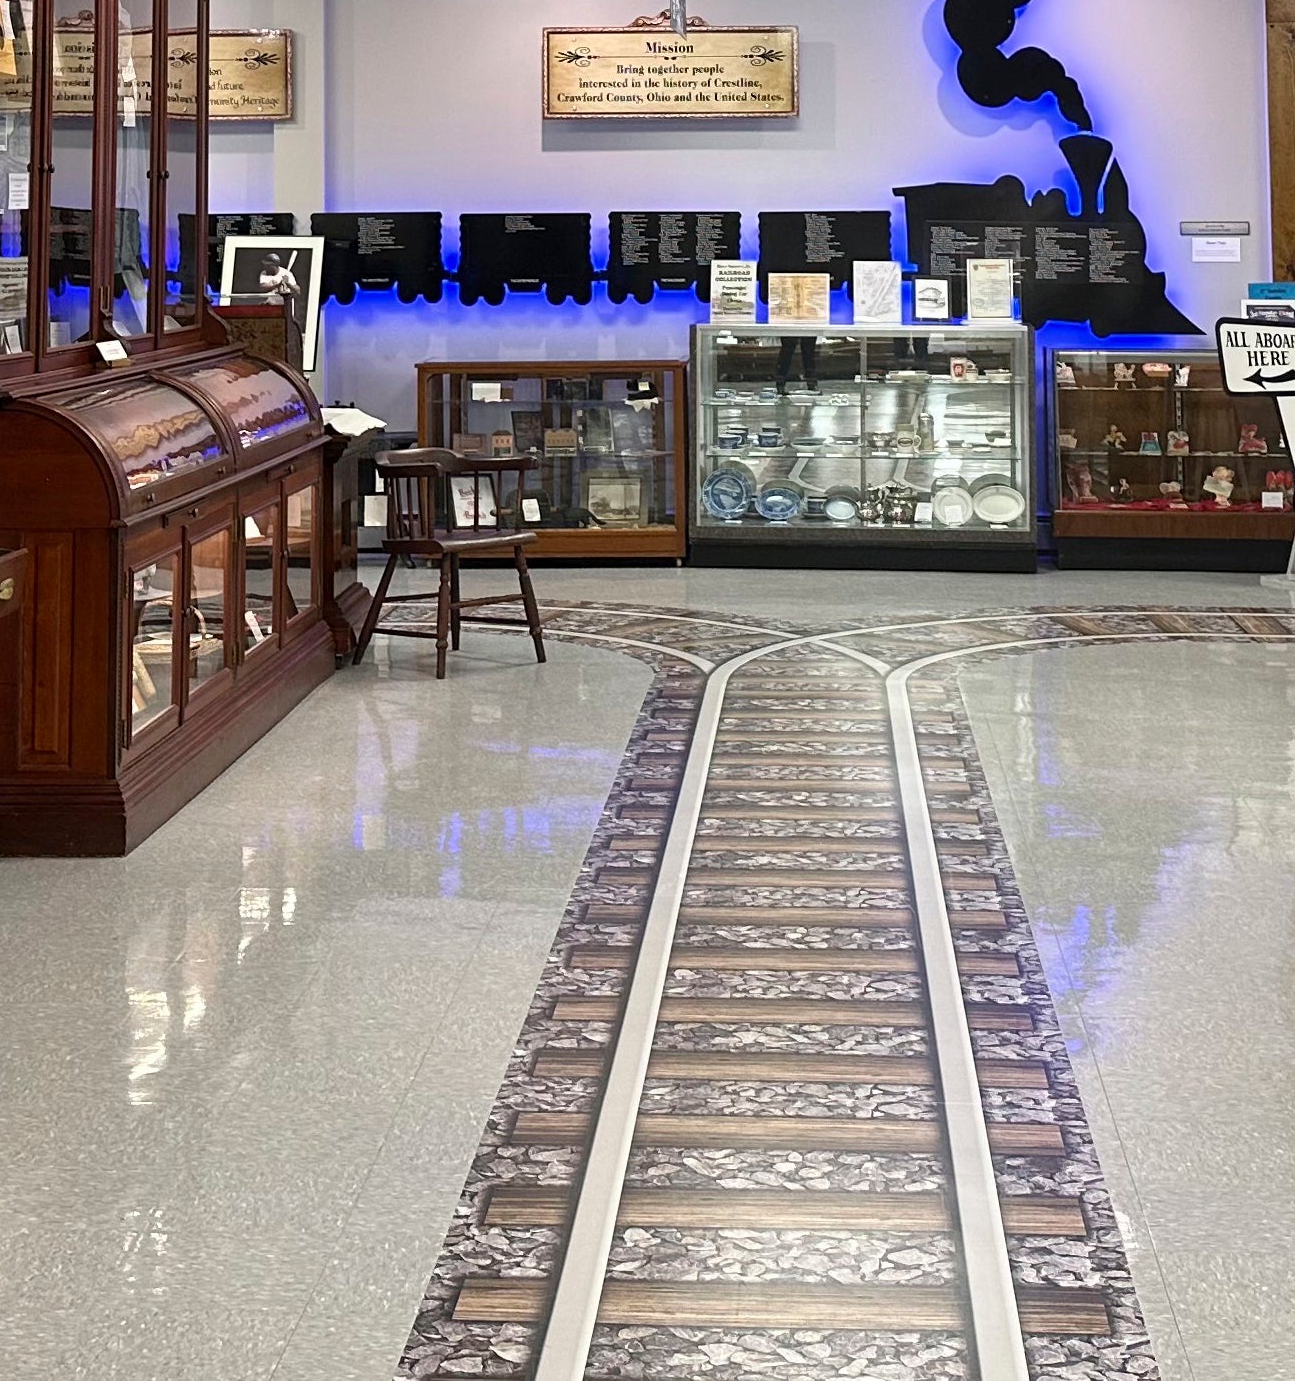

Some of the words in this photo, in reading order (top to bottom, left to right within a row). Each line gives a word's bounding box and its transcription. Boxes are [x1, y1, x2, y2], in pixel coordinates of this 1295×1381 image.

[645, 41, 694, 53] Mission
[616, 64, 644, 75] Bring
[647, 64, 689, 76] together
[692, 64, 725, 75] people
[217, 79, 244, 91] future
[578, 77, 628, 89] interested
[631, 78, 641, 88] in
[644, 78, 661, 88] the
[663, 77, 699, 90] history
[700, 77, 712, 87] of
[713, 77, 763, 89] Crestline,
[240, 94, 280, 109] Heritage
[557, 91, 603, 102] Crawford
[606, 92, 644, 104] County,
[646, 92, 671, 102] Ohio
[673, 92, 692, 102] and
[695, 92, 711, 102] the
[713, 92, 747, 102] United
[750, 92, 785, 102] States.
[1226, 330, 1250, 348] ALL
[1247, 350, 1291, 367] HERE
